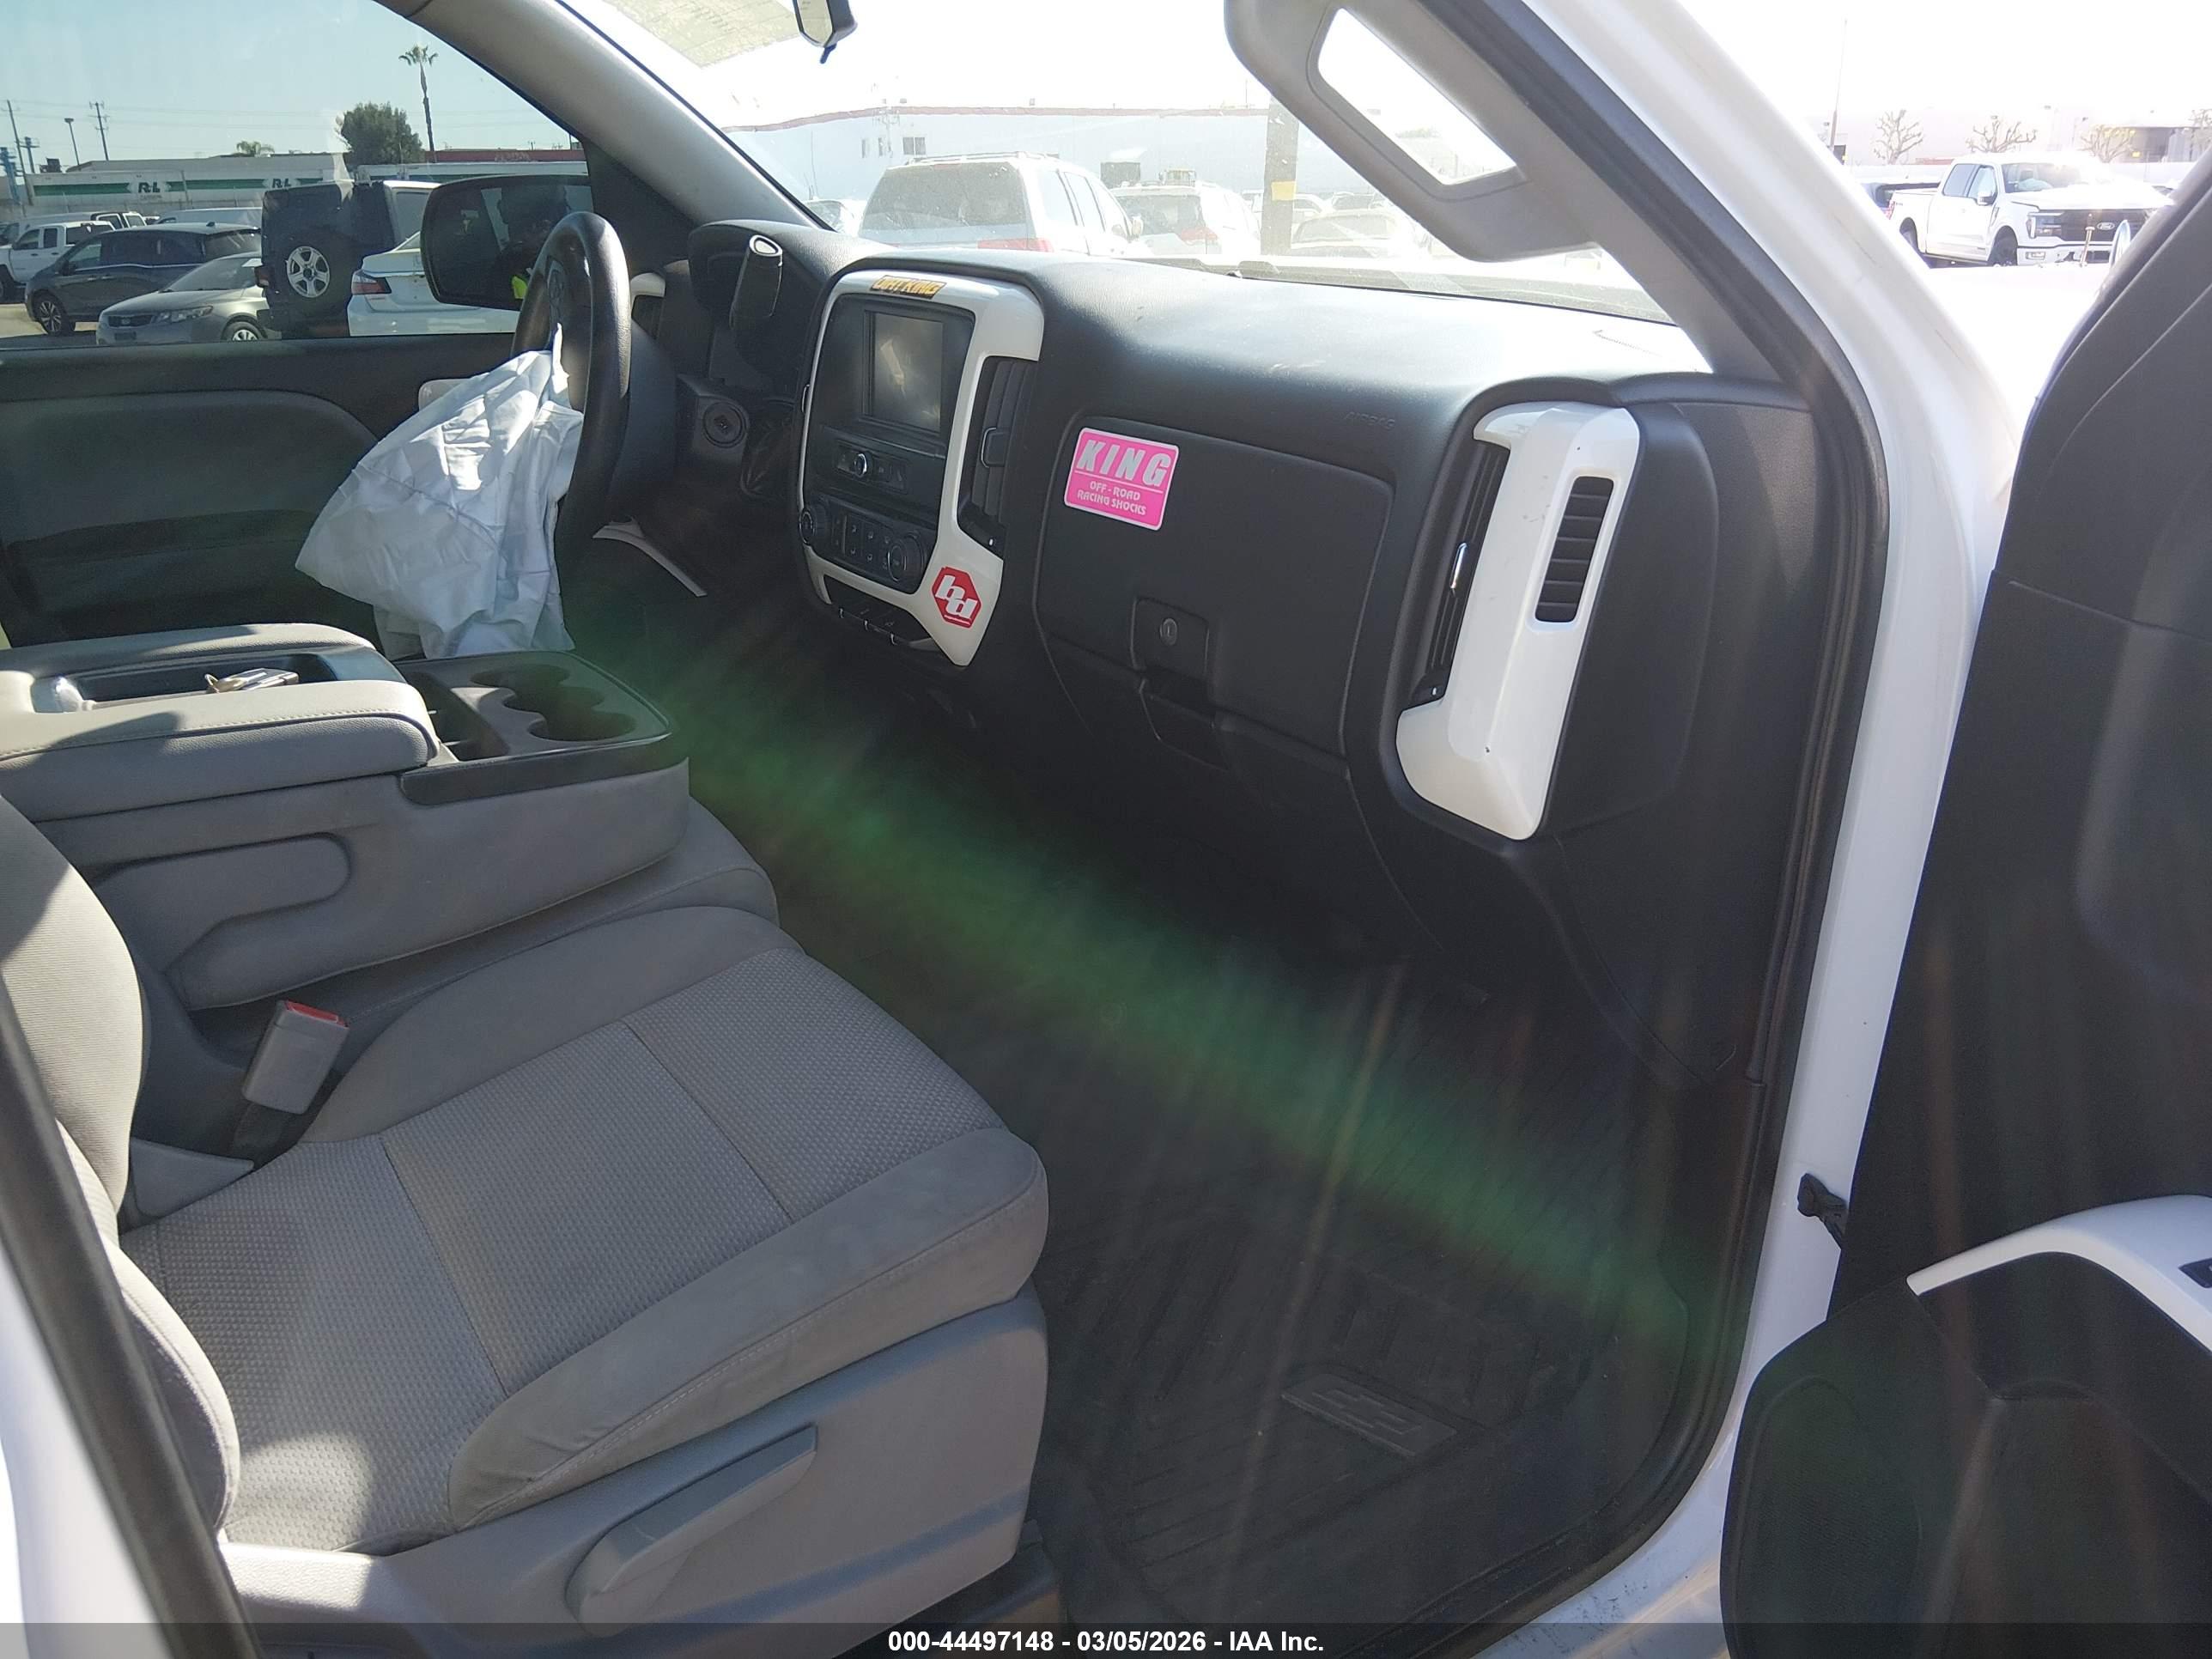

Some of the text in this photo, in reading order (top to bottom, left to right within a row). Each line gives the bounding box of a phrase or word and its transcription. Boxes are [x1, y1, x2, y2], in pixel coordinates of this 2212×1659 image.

[1075, 439, 1172, 487] KING
[1077, 489, 1146, 515] RACING SHOCKS
[1090, 481, 1106, 493] OFF
[1112, 486, 1140, 501] ROAD
